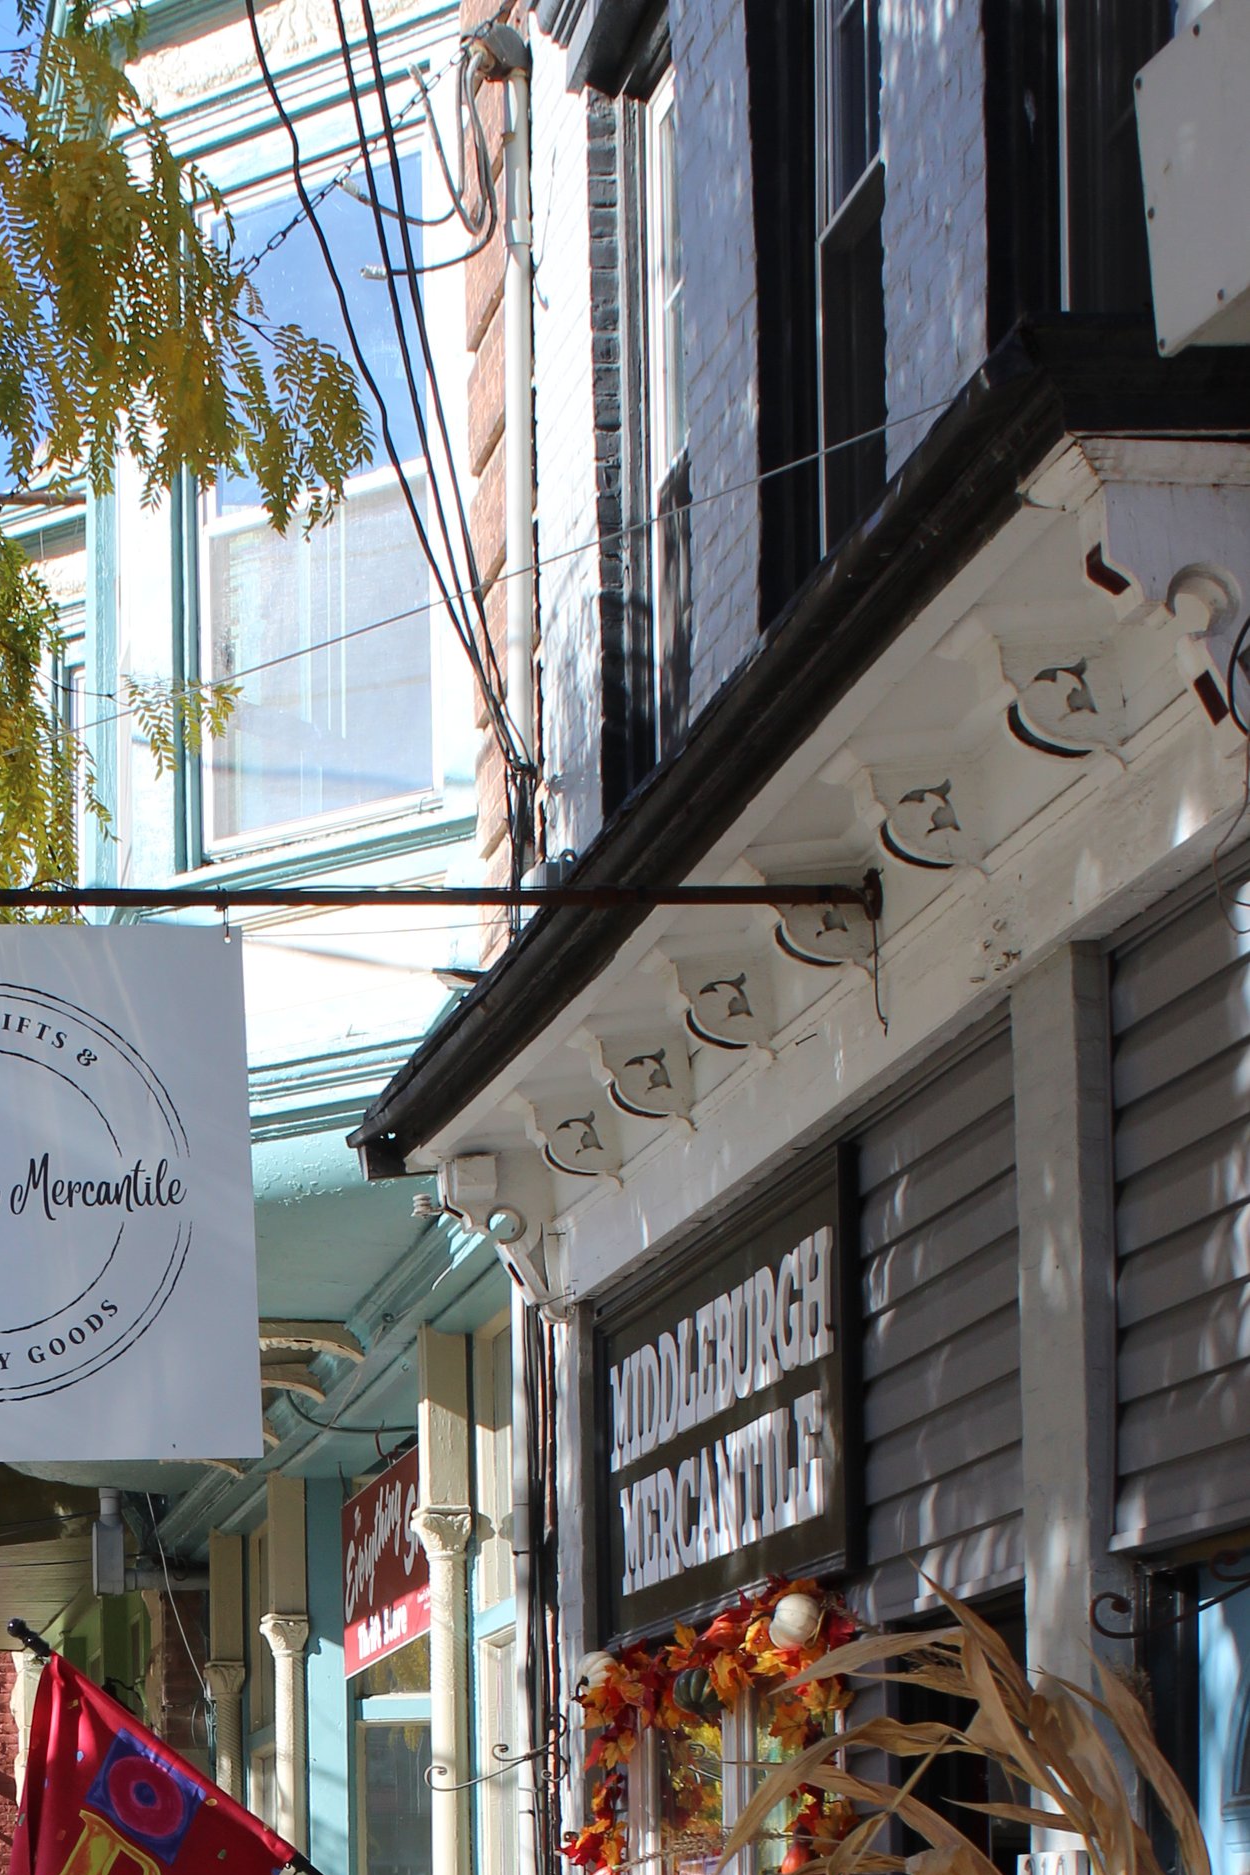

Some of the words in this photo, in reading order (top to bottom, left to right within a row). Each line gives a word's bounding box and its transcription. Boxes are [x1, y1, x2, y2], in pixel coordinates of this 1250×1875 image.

[76, 1047, 100, 1068] &
[10, 1152, 187, 1221] Mercantile
[27, 1298, 119, 1366] GOODS
[610, 1225, 834, 1473] MIDDLEBURGH
[619, 1390, 825, 1596] MERCANTILE
[344, 1479, 402, 1624] Everything
